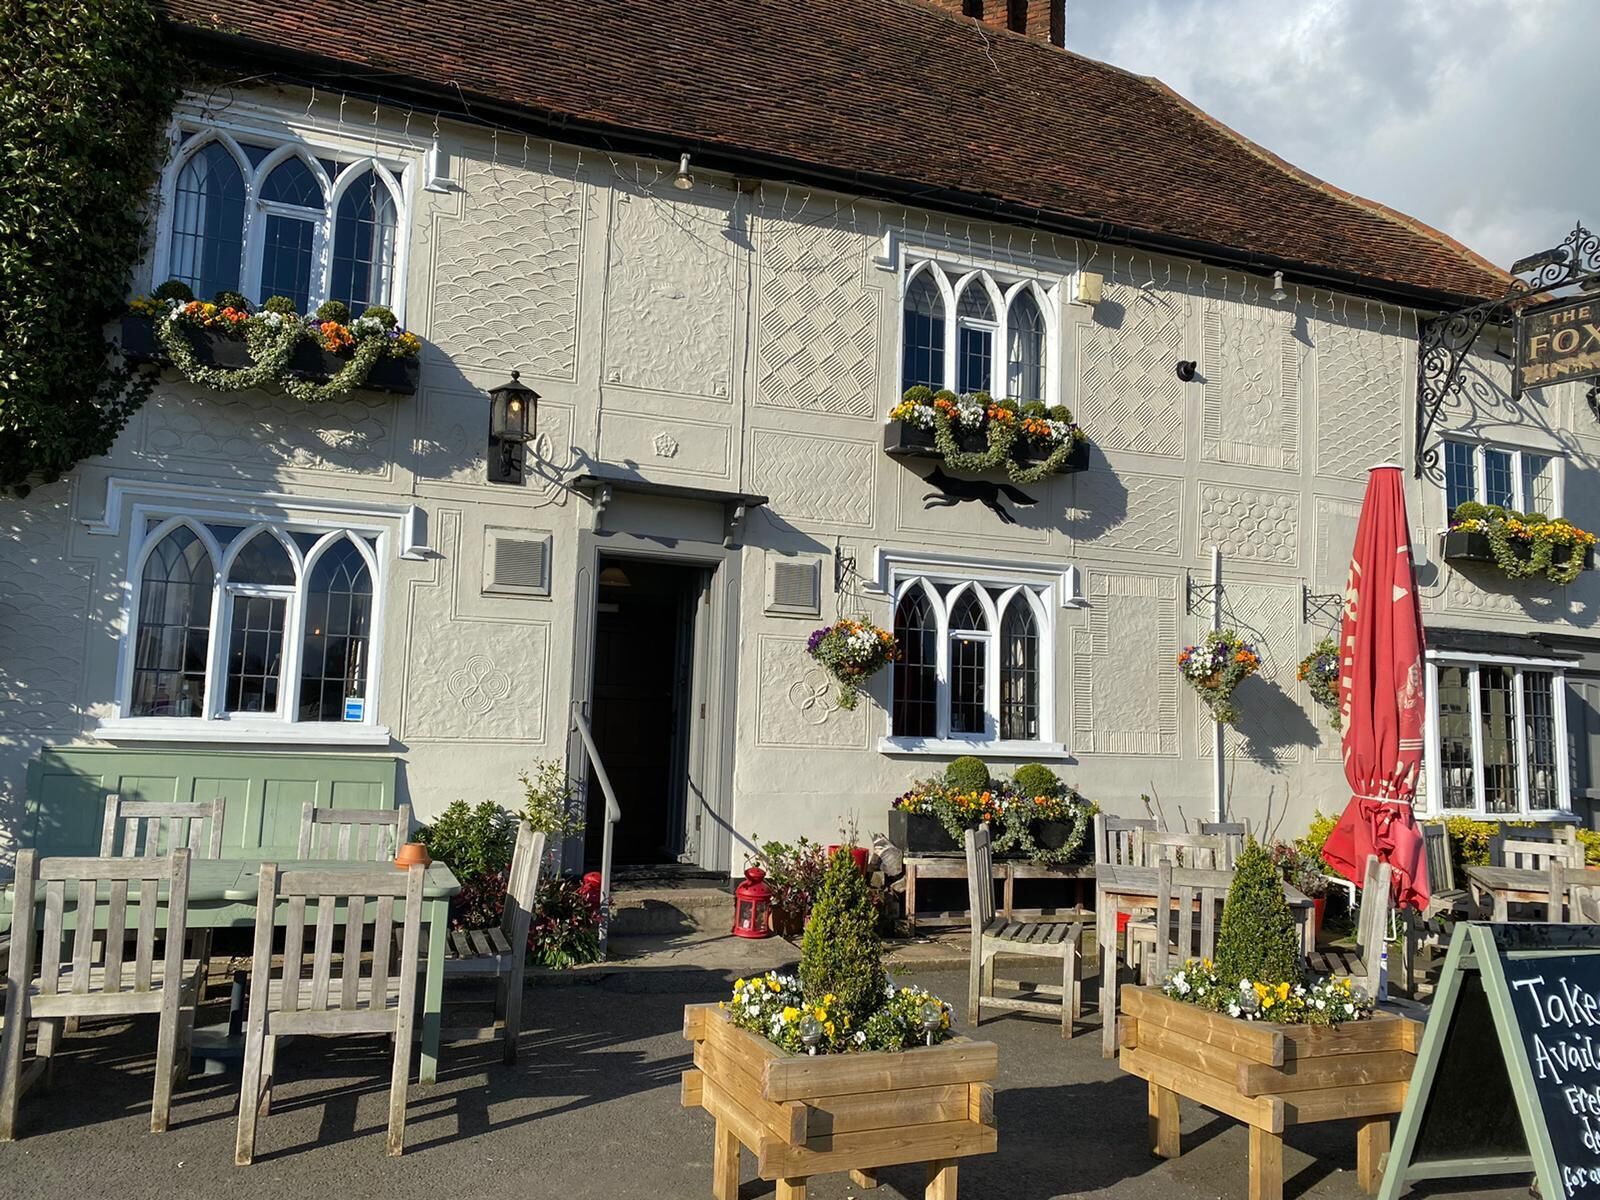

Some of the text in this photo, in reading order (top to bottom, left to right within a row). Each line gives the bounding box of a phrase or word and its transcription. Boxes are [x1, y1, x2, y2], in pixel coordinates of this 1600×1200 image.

[1550, 306, 1591, 325] THE
[1529, 323, 1600, 360] FOX
[1512, 975, 1600, 1028] Take
[1534, 1033, 1600, 1084] Avail
[1564, 1166, 1587, 1197] for
